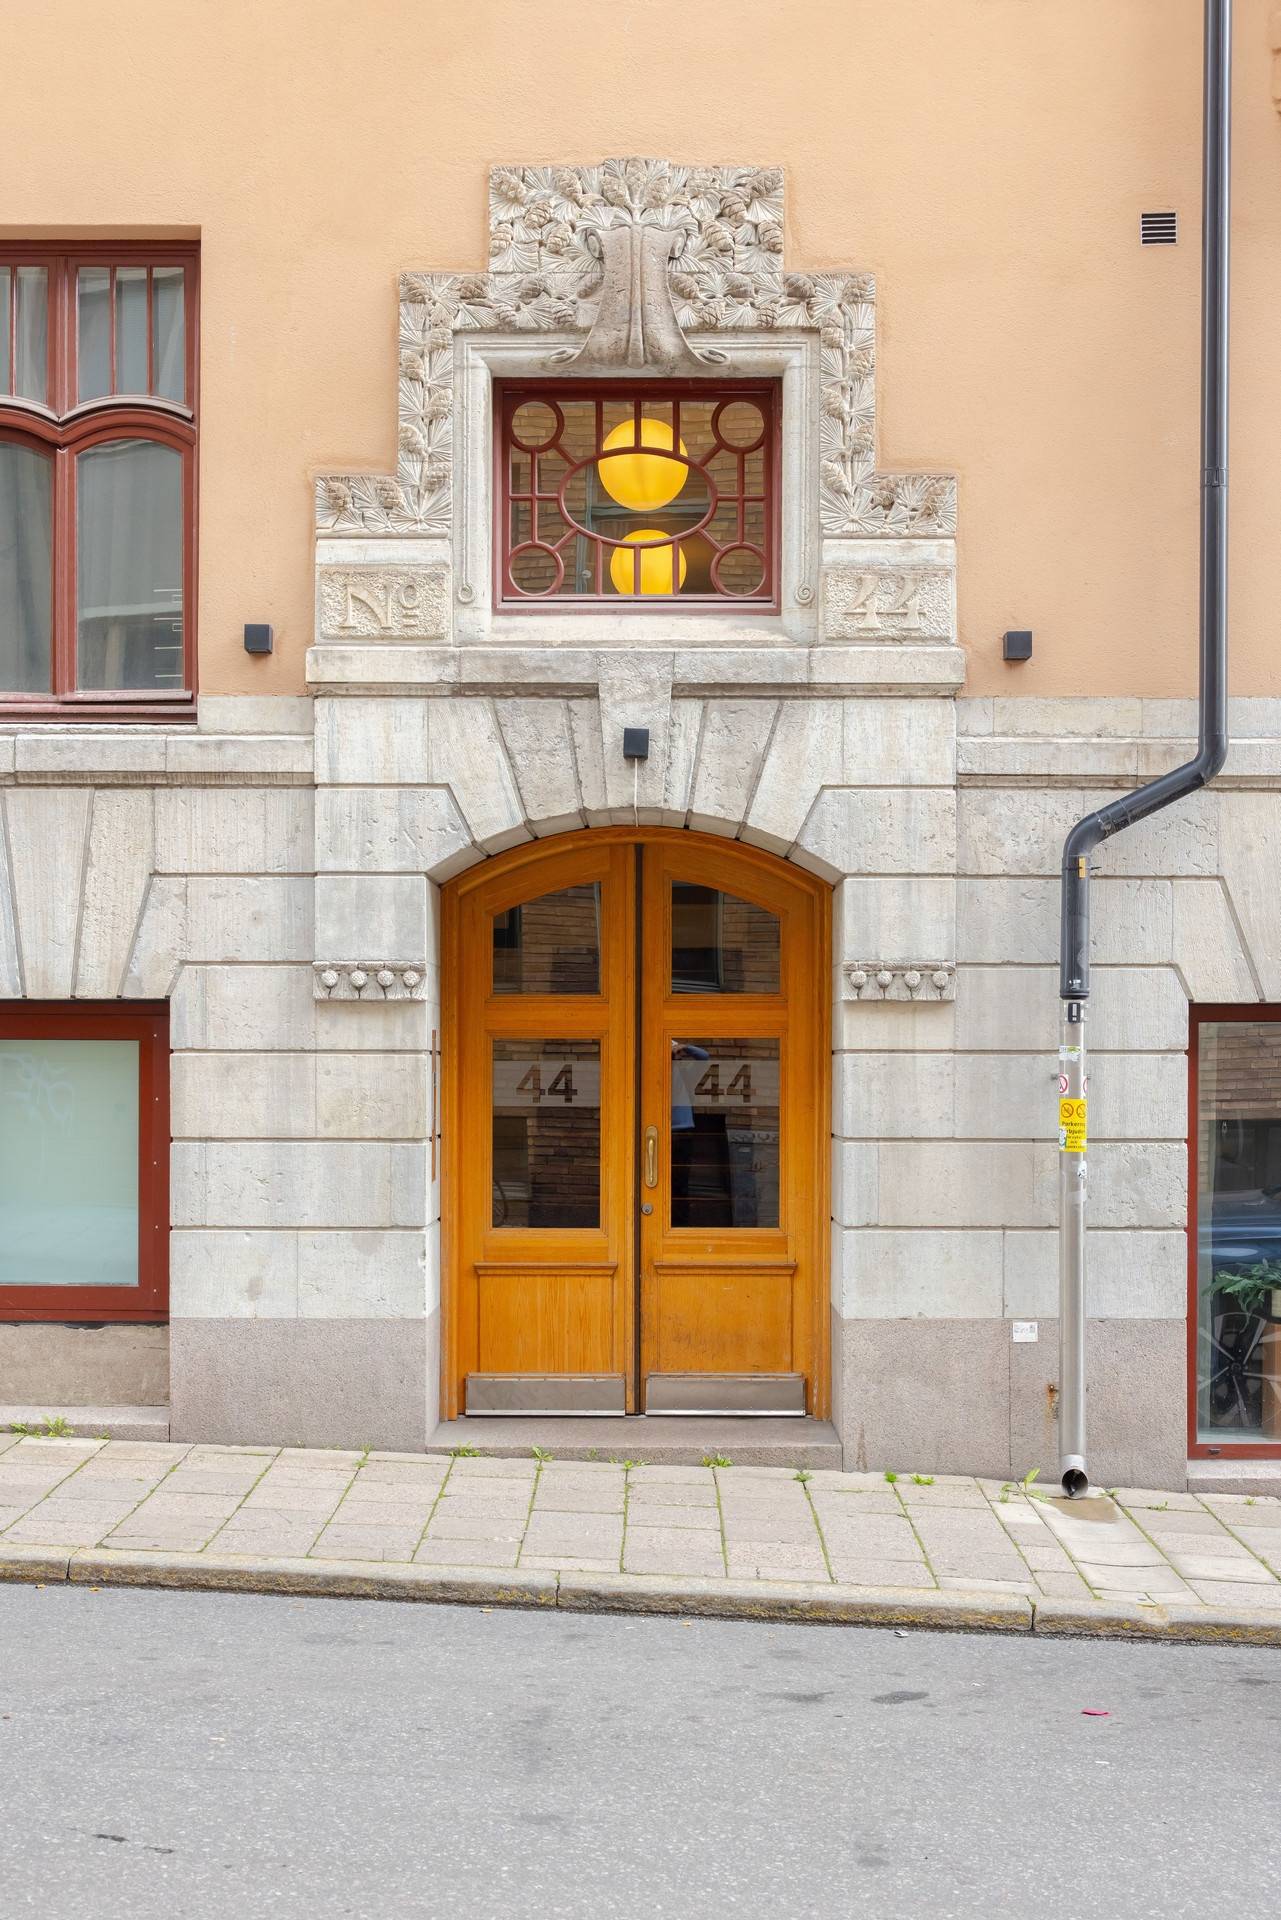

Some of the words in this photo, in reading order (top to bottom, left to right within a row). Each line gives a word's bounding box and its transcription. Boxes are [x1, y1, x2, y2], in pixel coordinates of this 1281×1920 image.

[842, 575, 927, 630] 44
[516, 1064, 578, 1104] 44
[694, 1064, 757, 1104] 44
